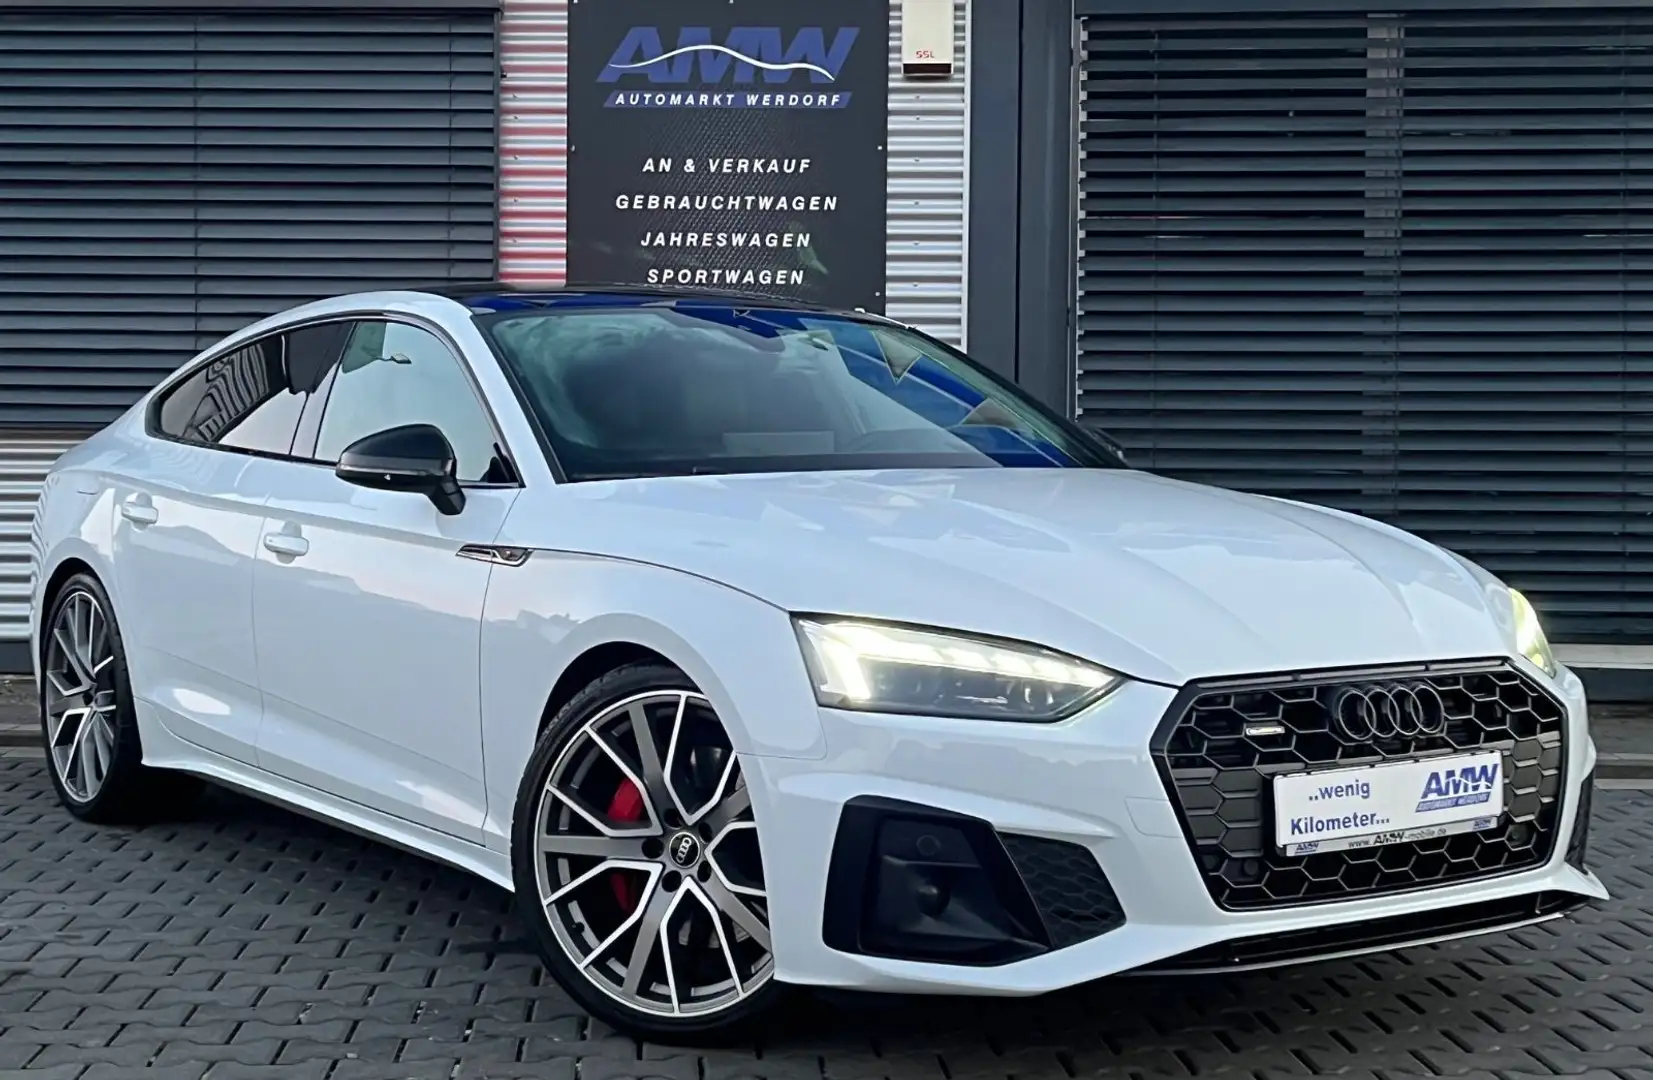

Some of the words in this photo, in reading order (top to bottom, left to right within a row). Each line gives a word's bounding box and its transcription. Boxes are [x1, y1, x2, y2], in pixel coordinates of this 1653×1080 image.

[596, 26, 861, 84] AMW
[615, 93, 734, 106] AUTOMARKT
[746, 93, 842, 106] WERDORF
[642, 158, 672, 173] AN
[684, 158, 696, 173] &
[709, 158, 812, 173] VERKAUF
[615, 195, 838, 211] GEBRAUCHTWAGEN
[640, 232, 811, 248] JAHRESWAGEN
[647, 268, 805, 285] SPORTWAGEN
[1421, 763, 1499, 799] AMW
[1291, 812, 1390, 835] Kilometer...
